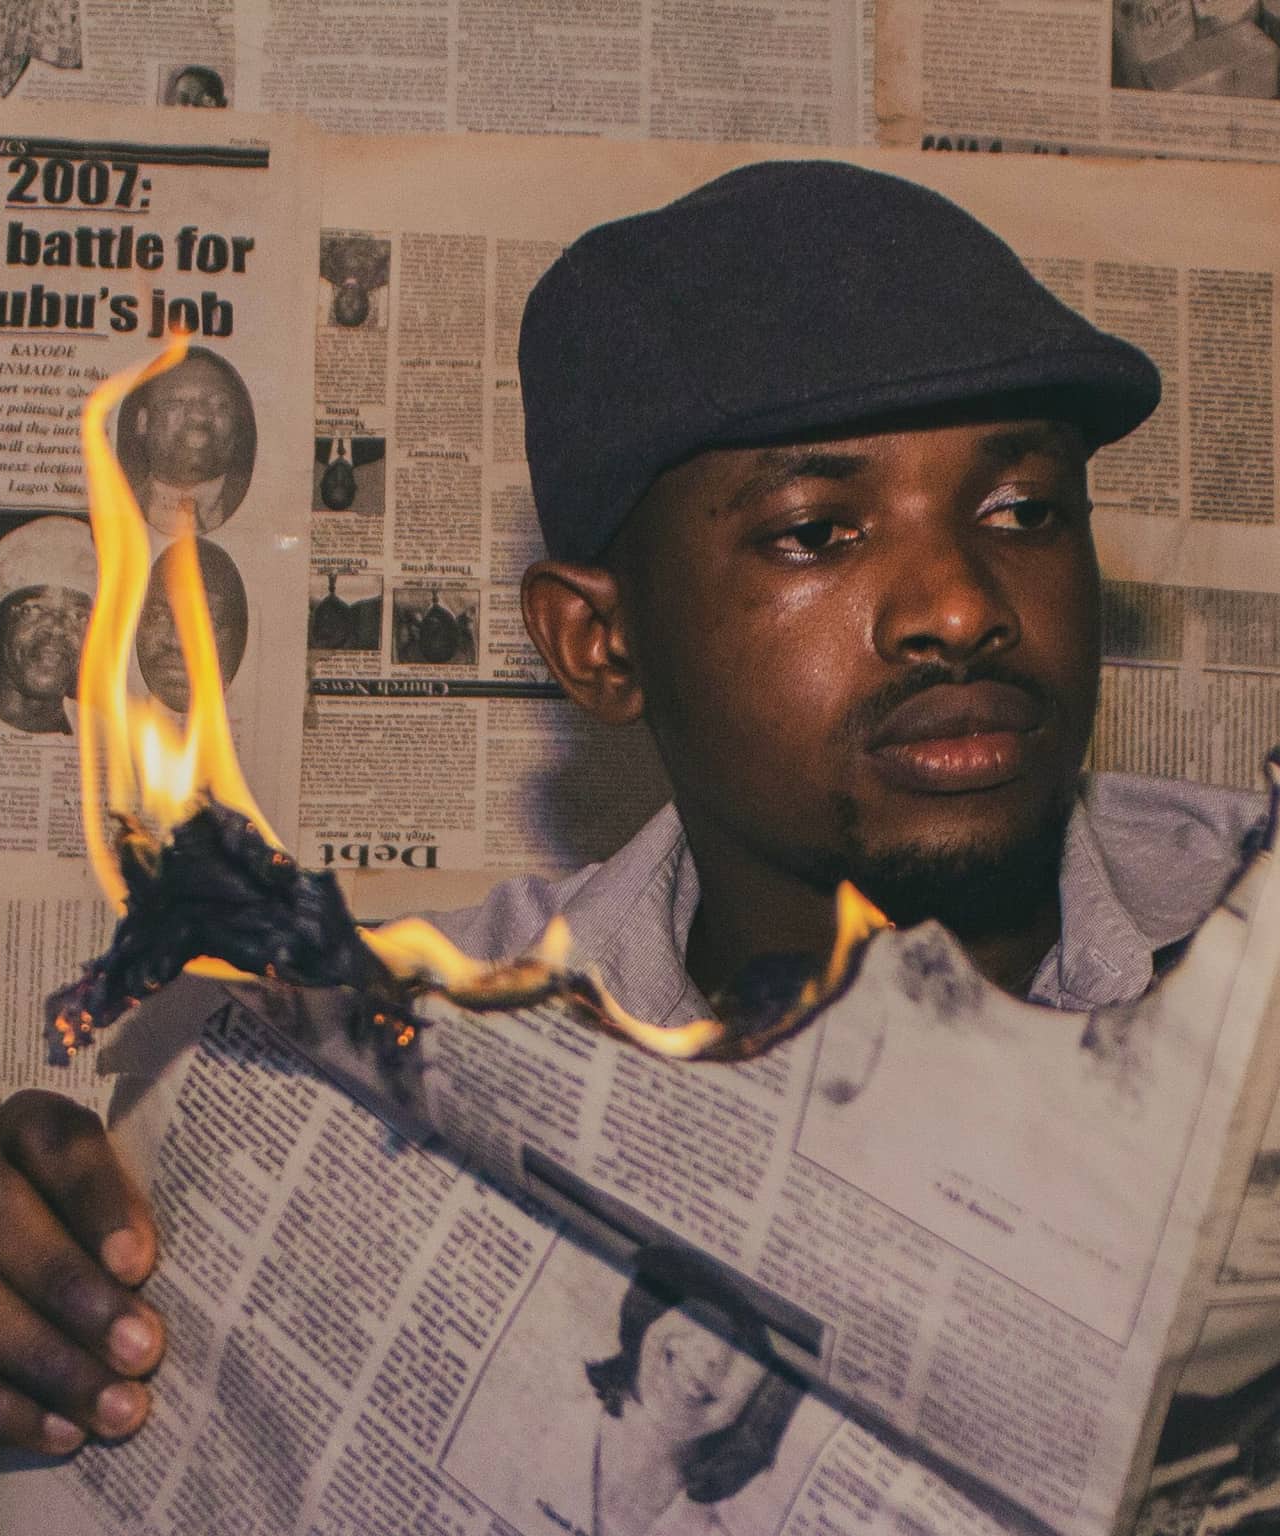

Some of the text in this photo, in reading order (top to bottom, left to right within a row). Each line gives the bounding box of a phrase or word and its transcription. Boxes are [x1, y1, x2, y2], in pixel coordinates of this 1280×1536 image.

[6, 158, 154, 209] 2007:
[6, 221, 164, 273] battle
[175, 226, 256, 275] for
[146, 289, 234, 340] job
[10, 343, 78, 358] KAYODE
[23, 385, 62, 398] writes
[7, 403, 64, 417] political
[0, 440, 24, 453] will
[0, 462, 33, 473] next
[33, 461, 83, 475] election
[317, 841, 441, 871] Debt
